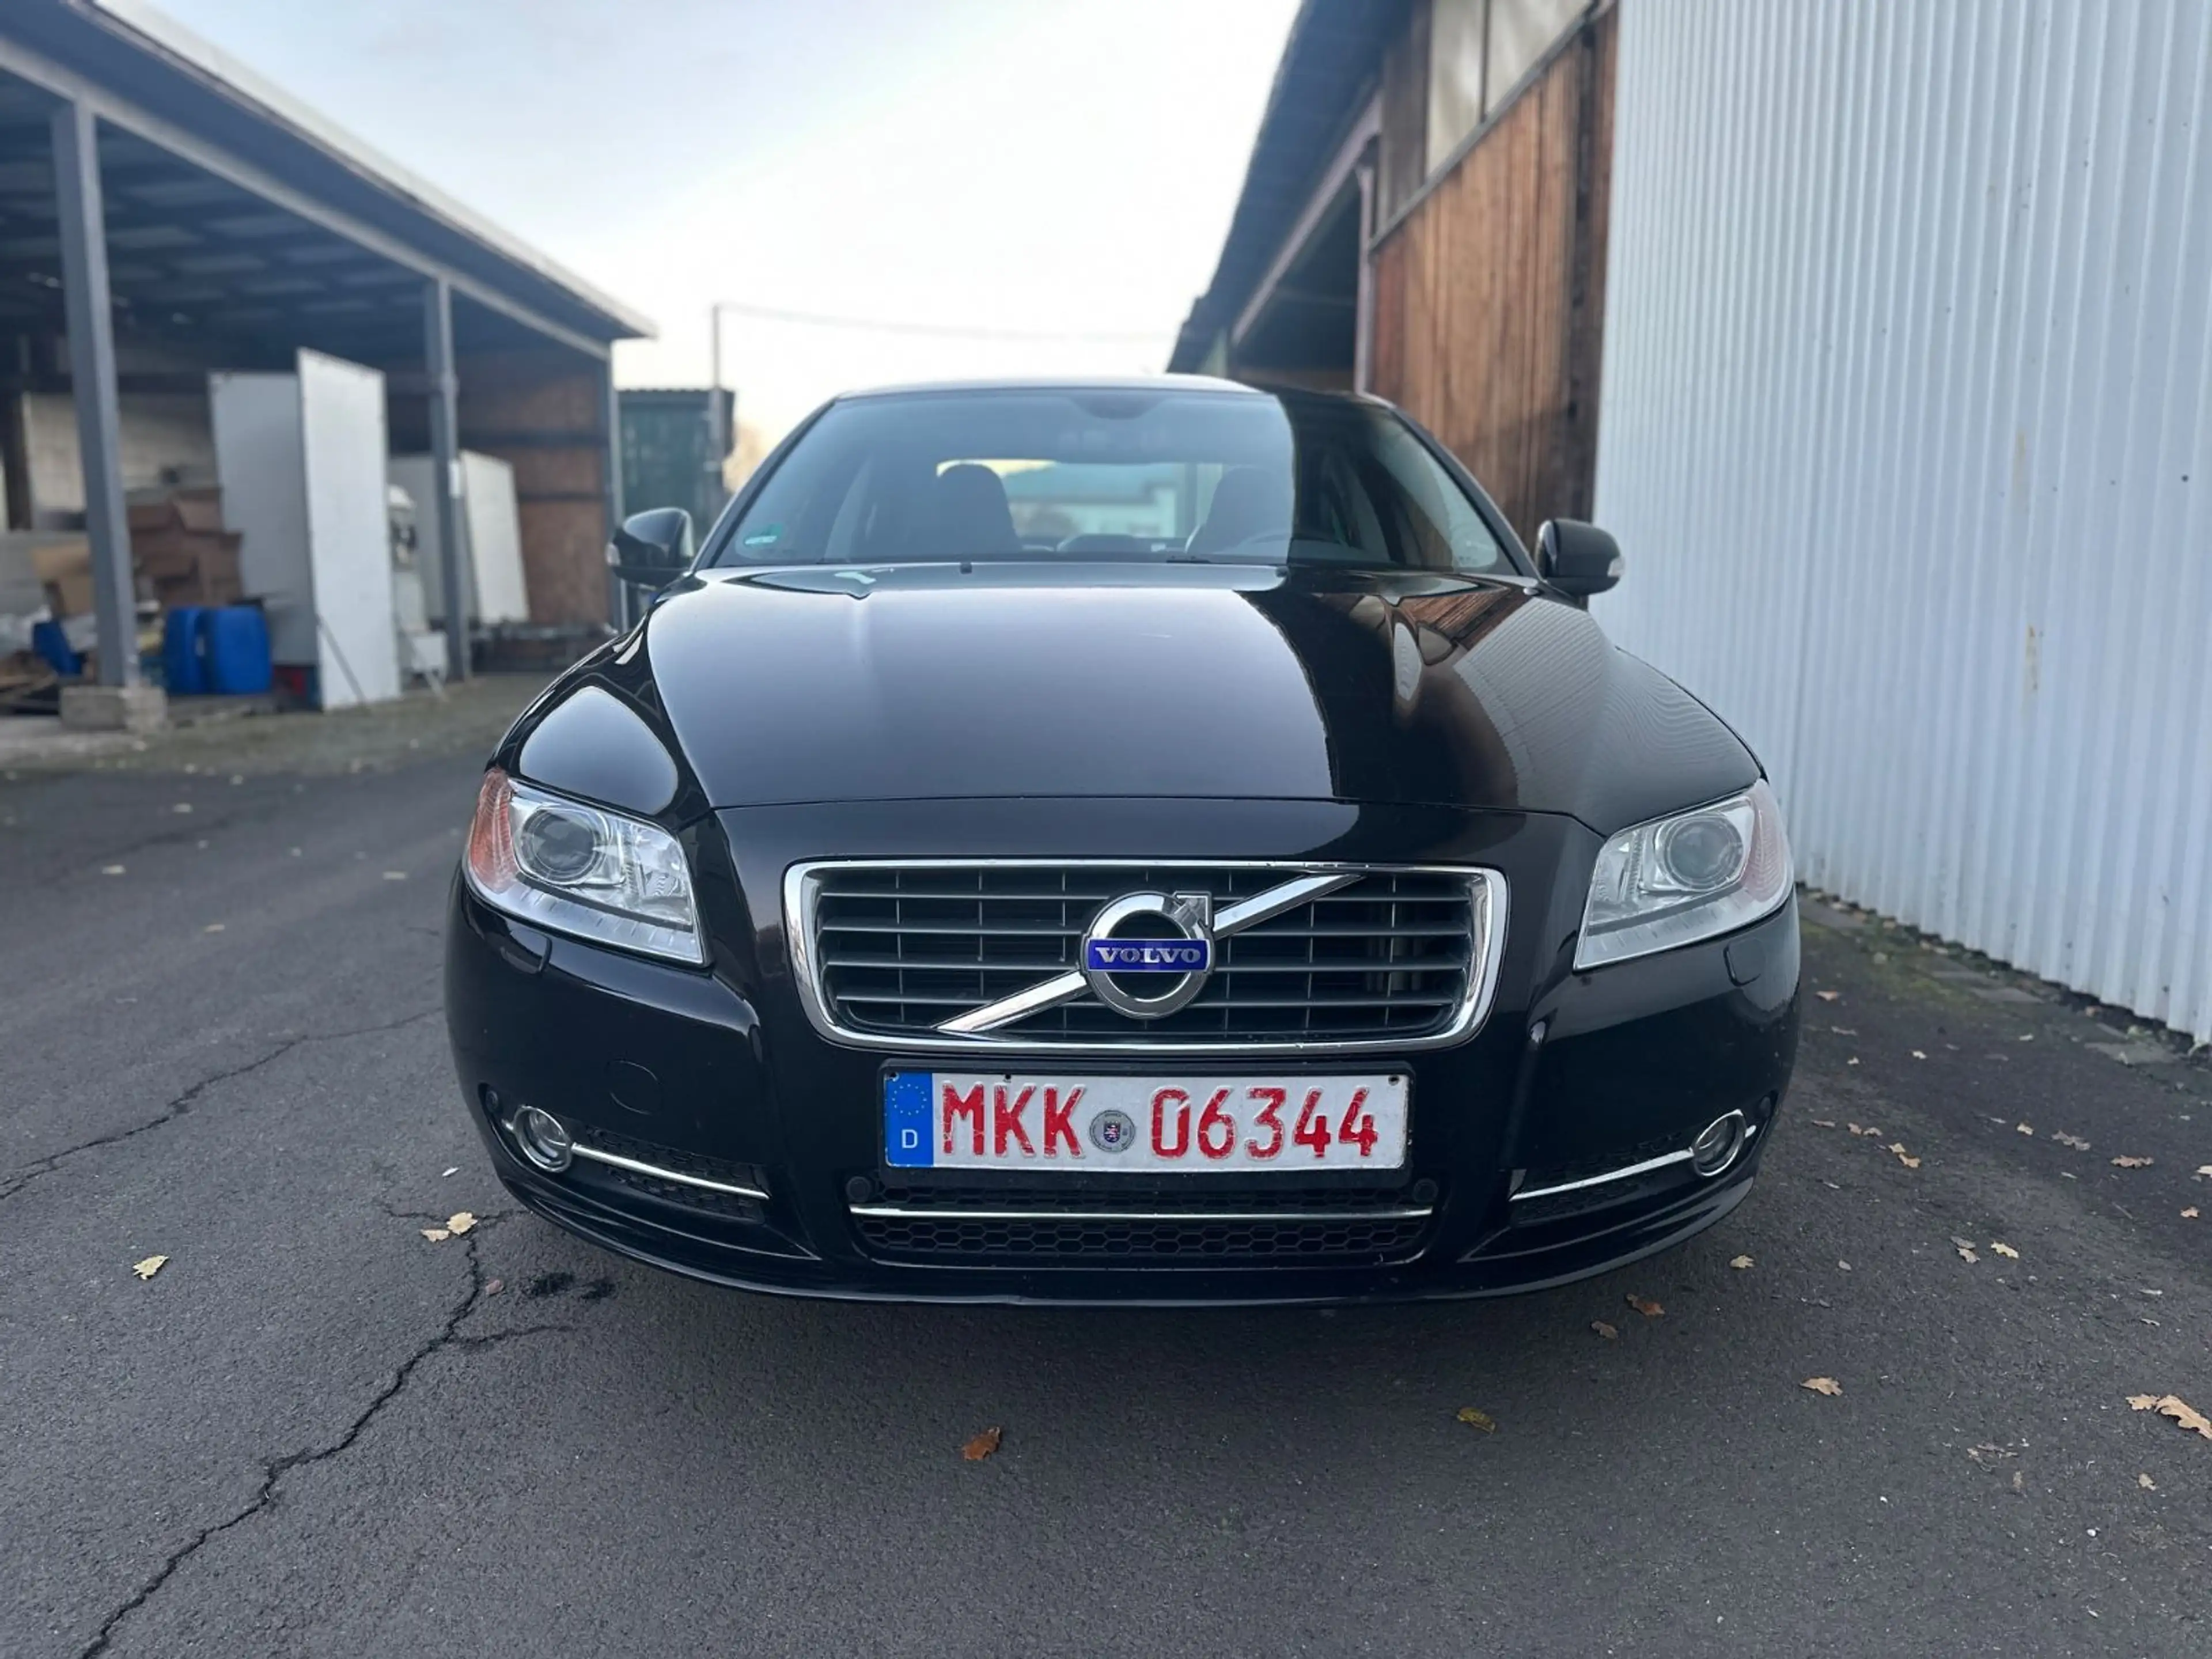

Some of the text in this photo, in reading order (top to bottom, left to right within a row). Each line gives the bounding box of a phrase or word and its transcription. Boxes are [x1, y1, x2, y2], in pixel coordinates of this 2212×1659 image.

[1095, 946, 1201, 964] VOLVO
[941, 1081, 1085, 1158] MKK
[1151, 1085, 1380, 1159] 06344
[901, 1129, 918, 1149] D
